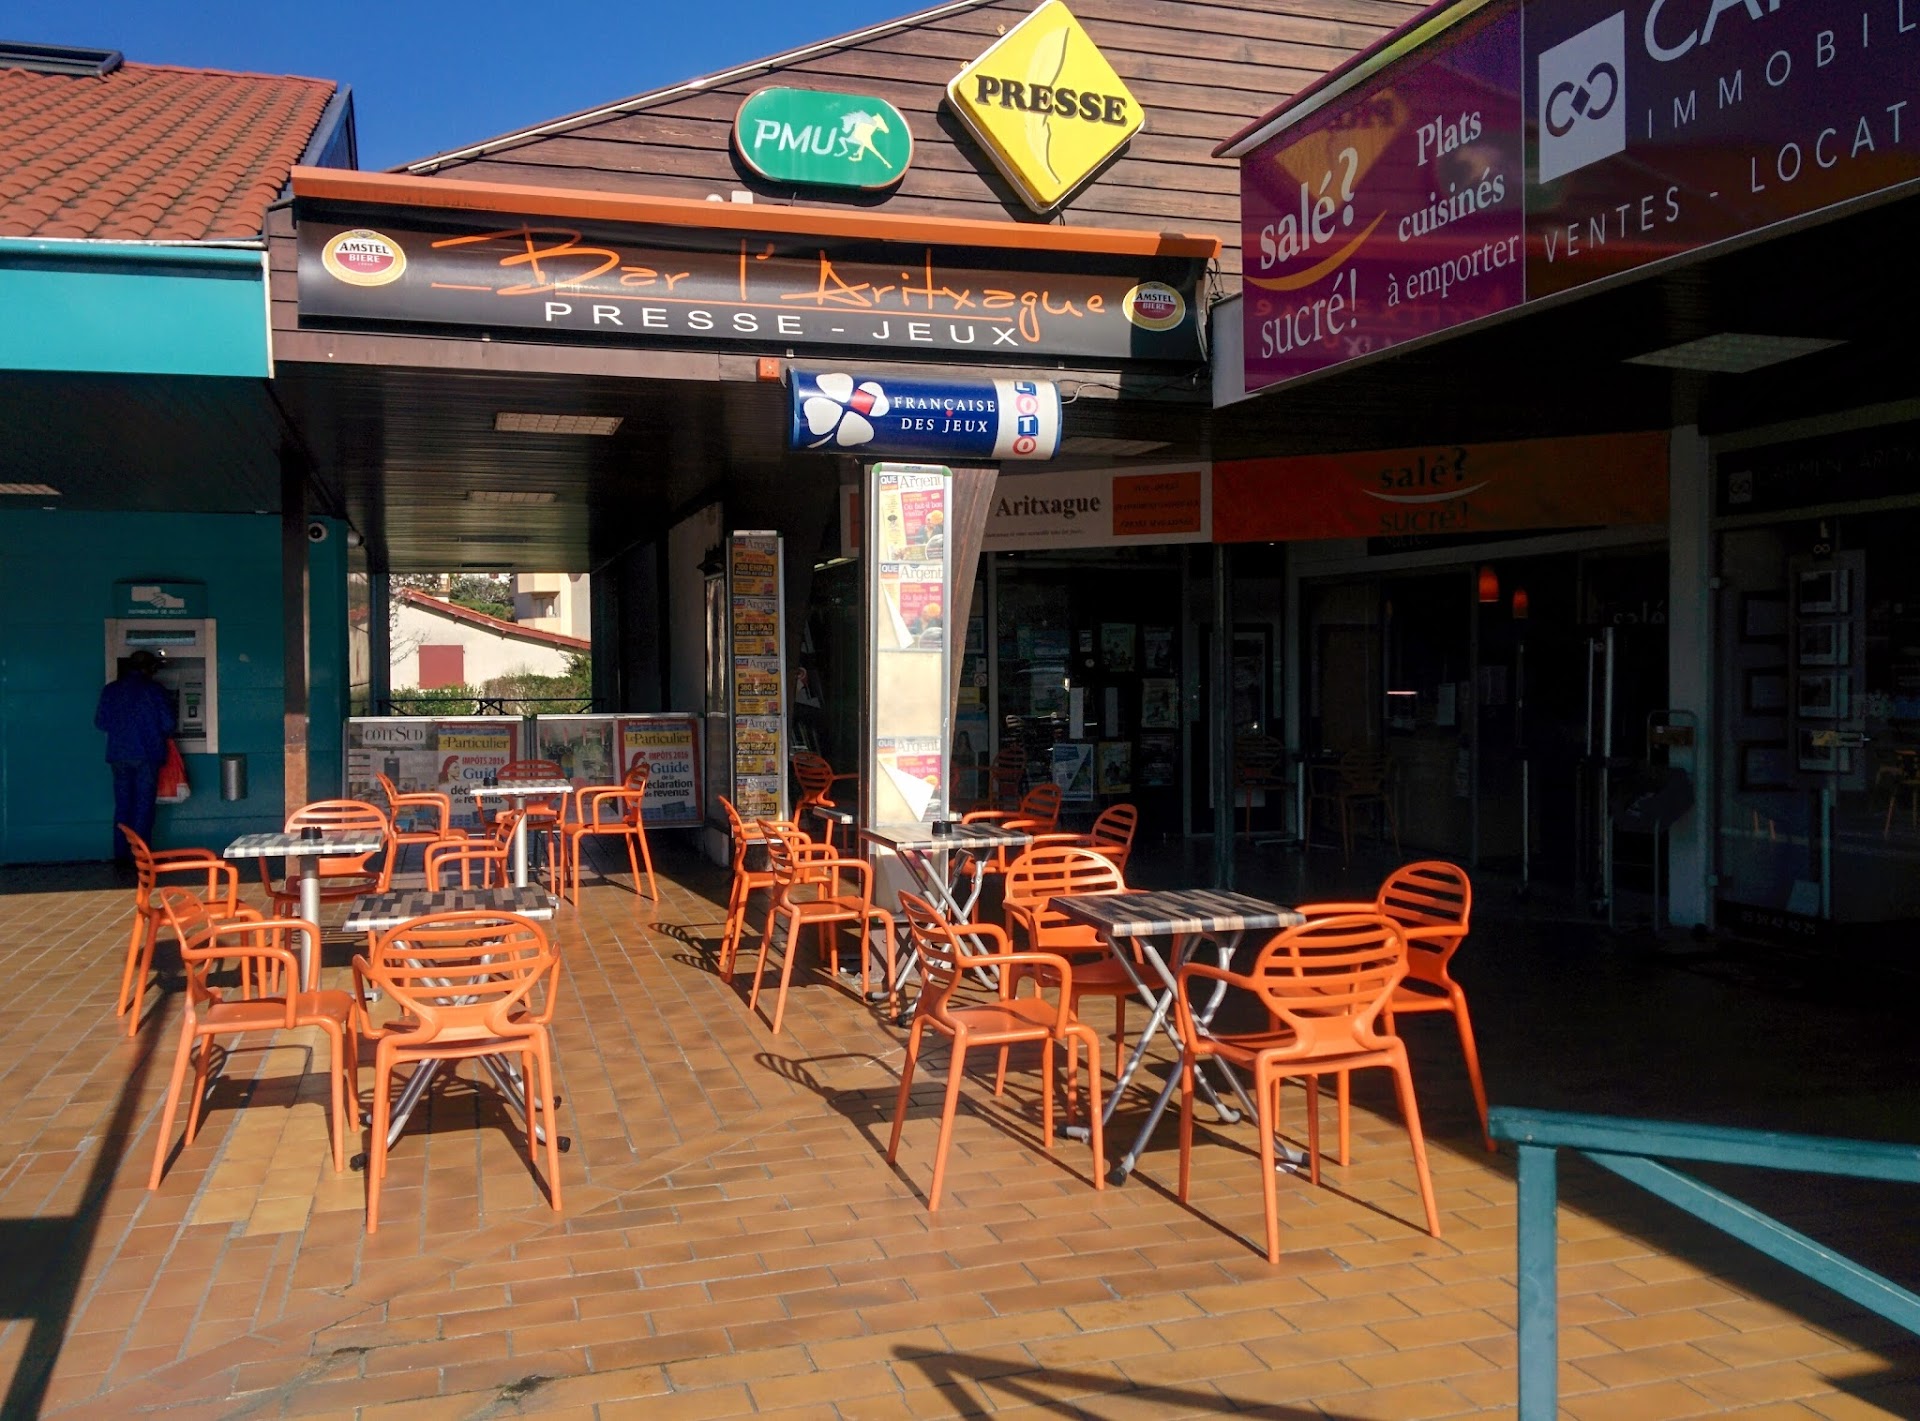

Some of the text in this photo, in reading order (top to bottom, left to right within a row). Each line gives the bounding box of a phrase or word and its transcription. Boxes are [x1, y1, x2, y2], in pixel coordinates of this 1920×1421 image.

[975, 75, 1127, 127] PRESSE
[754, 119, 838, 156] PMU
[1416, 110, 1483, 167] Plats
[1545, 187, 1679, 264] VENTES
[1751, 101, 1908, 193] LOCAT
[1260, 146, 1359, 270] salé?
[1399, 167, 1506, 243] cuisinés
[340, 242, 390, 255] AMSTEL
[349, 253, 380, 263] BIERE
[432, 223, 690, 296] Bar
[1388, 234, 1520, 307] à emporter
[1136, 292, 1173, 303] AMSTEL
[1142, 302, 1166, 311] BIERE
[1262, 268, 1357, 360] sucré!
[546, 301, 803, 335] PRESSE
[872, 319, 1018, 346] JEUX
[901, 418, 988, 434] DES JEUX
[1013, 381, 1038, 455] LOTO
[1381, 447, 1467, 489] salé?
[880, 475, 897, 485] QUE
[900, 475, 942, 490] Argent
[1380, 501, 1468, 533] sucré!
[900, 566, 943, 582] Argent
[747, 599, 777, 610] Argent
[749, 623, 773, 632] EHPAD
[749, 659, 780, 670] Argent
[749, 719, 778, 730] Argent
[448, 736, 509, 749] Particulier
[634, 731, 691, 745] Particulier
[898, 738, 941, 754] Argent
[462, 755, 507, 765] IMPÔTS 2016
[650, 761, 689, 774] Guide
[653, 788, 690, 799] revenus
